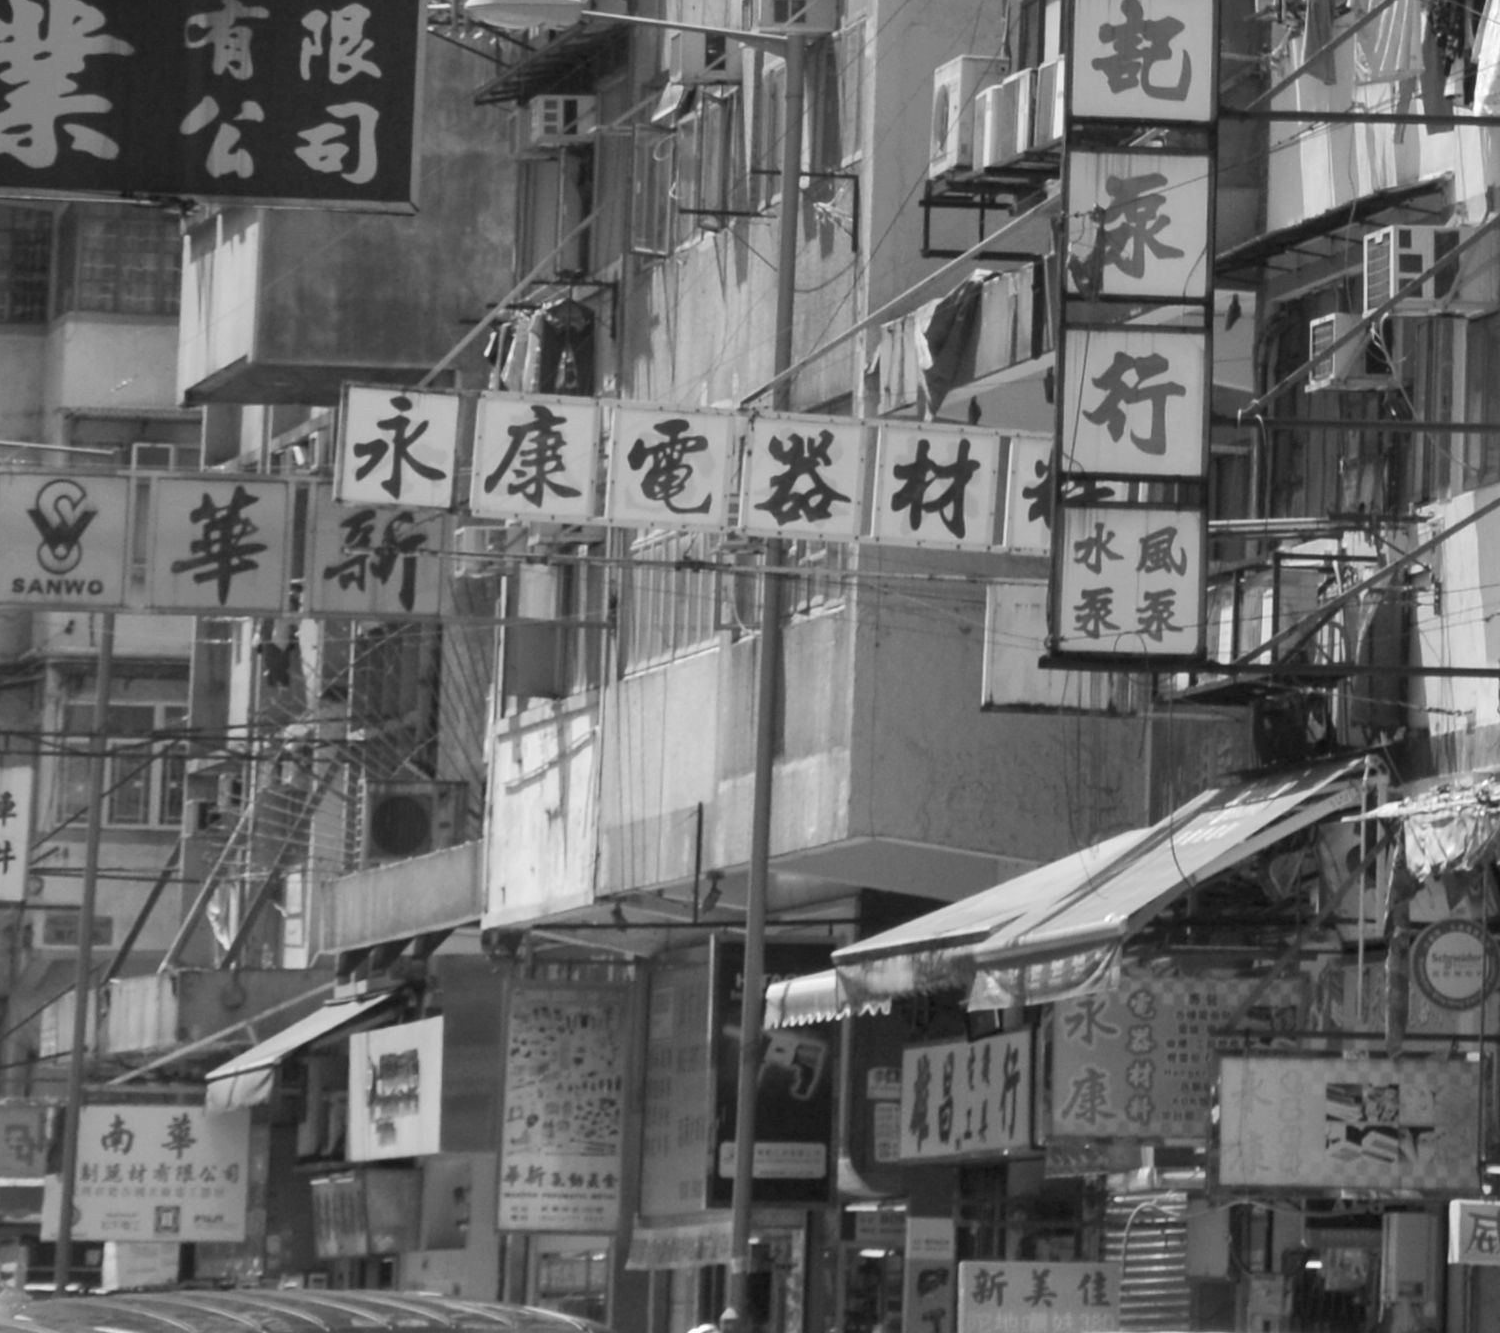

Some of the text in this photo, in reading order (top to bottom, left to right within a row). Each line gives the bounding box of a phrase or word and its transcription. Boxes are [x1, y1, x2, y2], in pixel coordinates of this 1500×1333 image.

[12, 579, 104, 596] SANWO
[971, 1268, 1111, 1308] 新美佳
